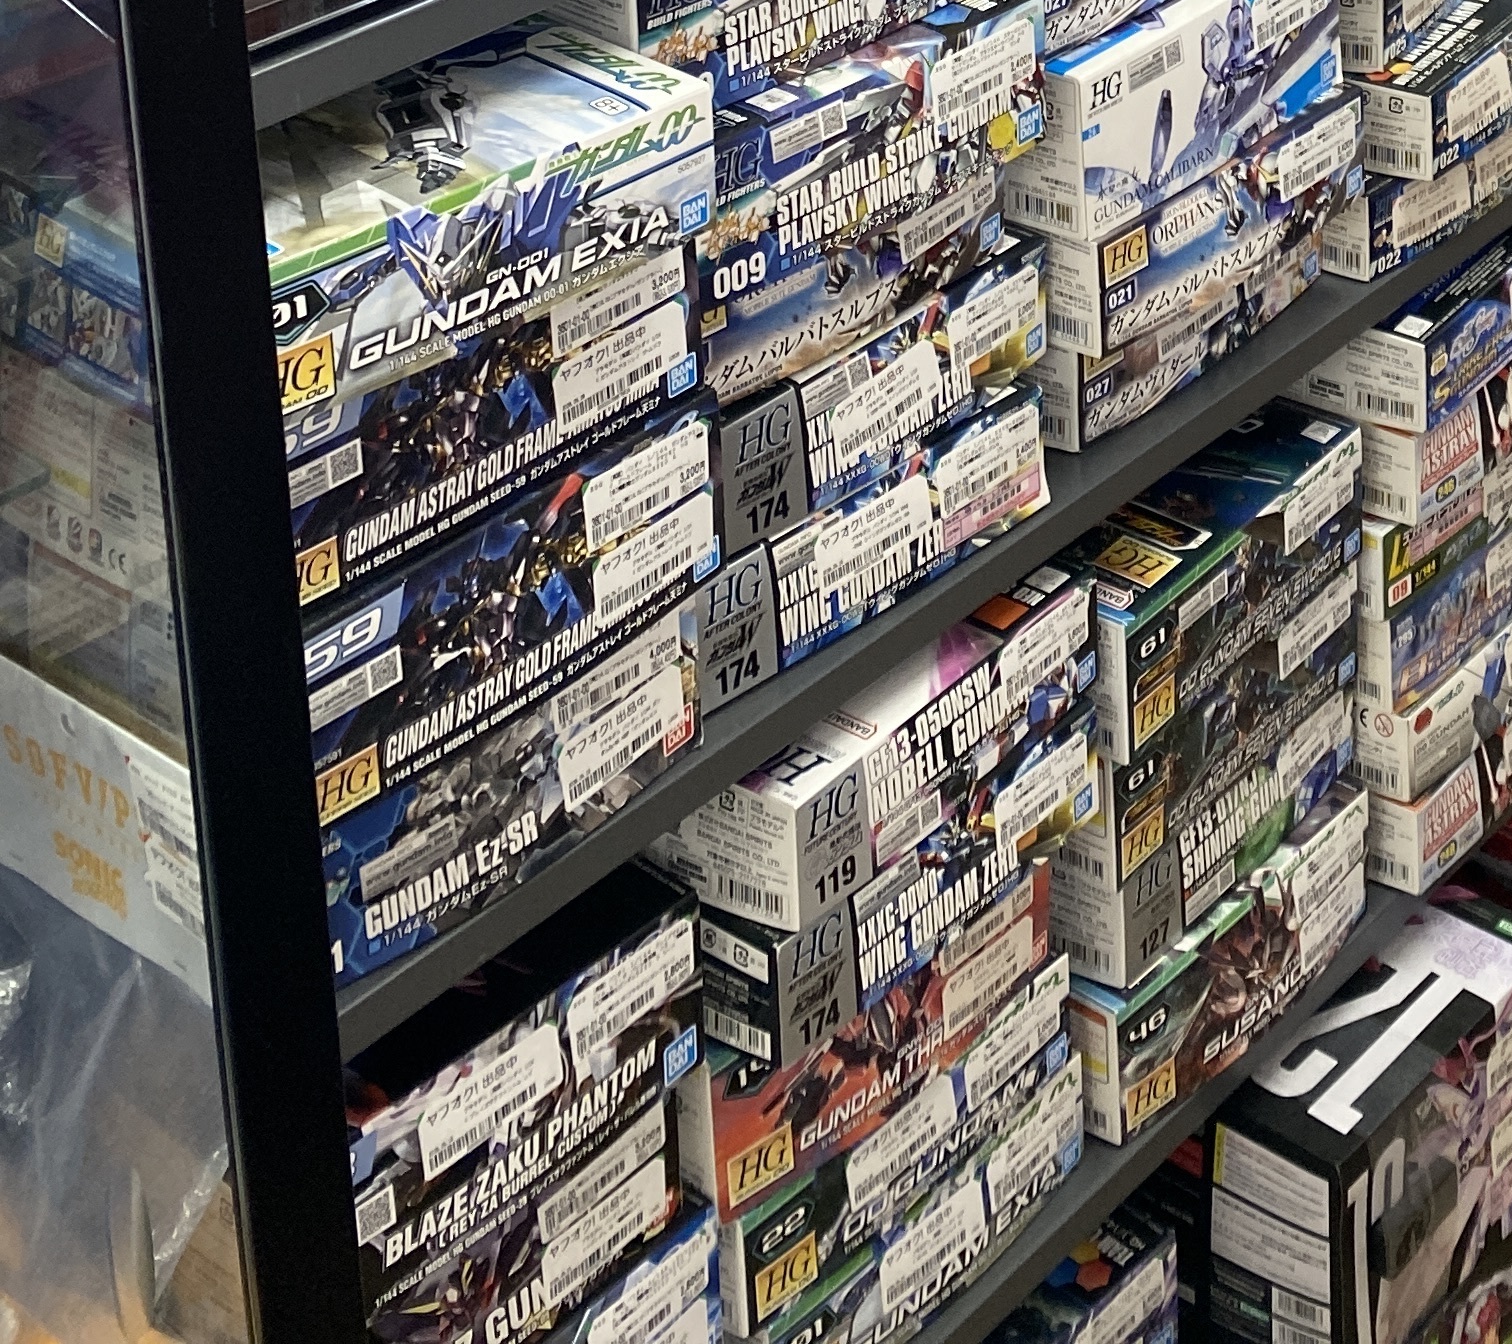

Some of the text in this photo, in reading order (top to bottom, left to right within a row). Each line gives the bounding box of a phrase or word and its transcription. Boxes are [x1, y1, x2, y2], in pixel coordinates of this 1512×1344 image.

[725, 8, 771, 40] STAR
[726, 21, 811, 75] PLAVSKY
[350, 259, 560, 368] GUNDAM
[572, 206, 670, 272] EXIA
[487, 248, 549, 283] GN-001
[571, 245, 647, 289] ガンダムエクシア
[713, 250, 766, 300] 009
[738, 401, 791, 460] HG
[747, 492, 788, 533] 174
[306, 606, 382, 673] 59
[872, 747, 947, 821] NOBELL
[365, 811, 538, 940] GUNDAM Ez-SR
[859, 842, 1017, 991] WING GUNDAM ZERO
[1128, 1012, 1167, 1043] 46
[385, 1041, 657, 1267] BLAZE ZAKU PHANTOM
